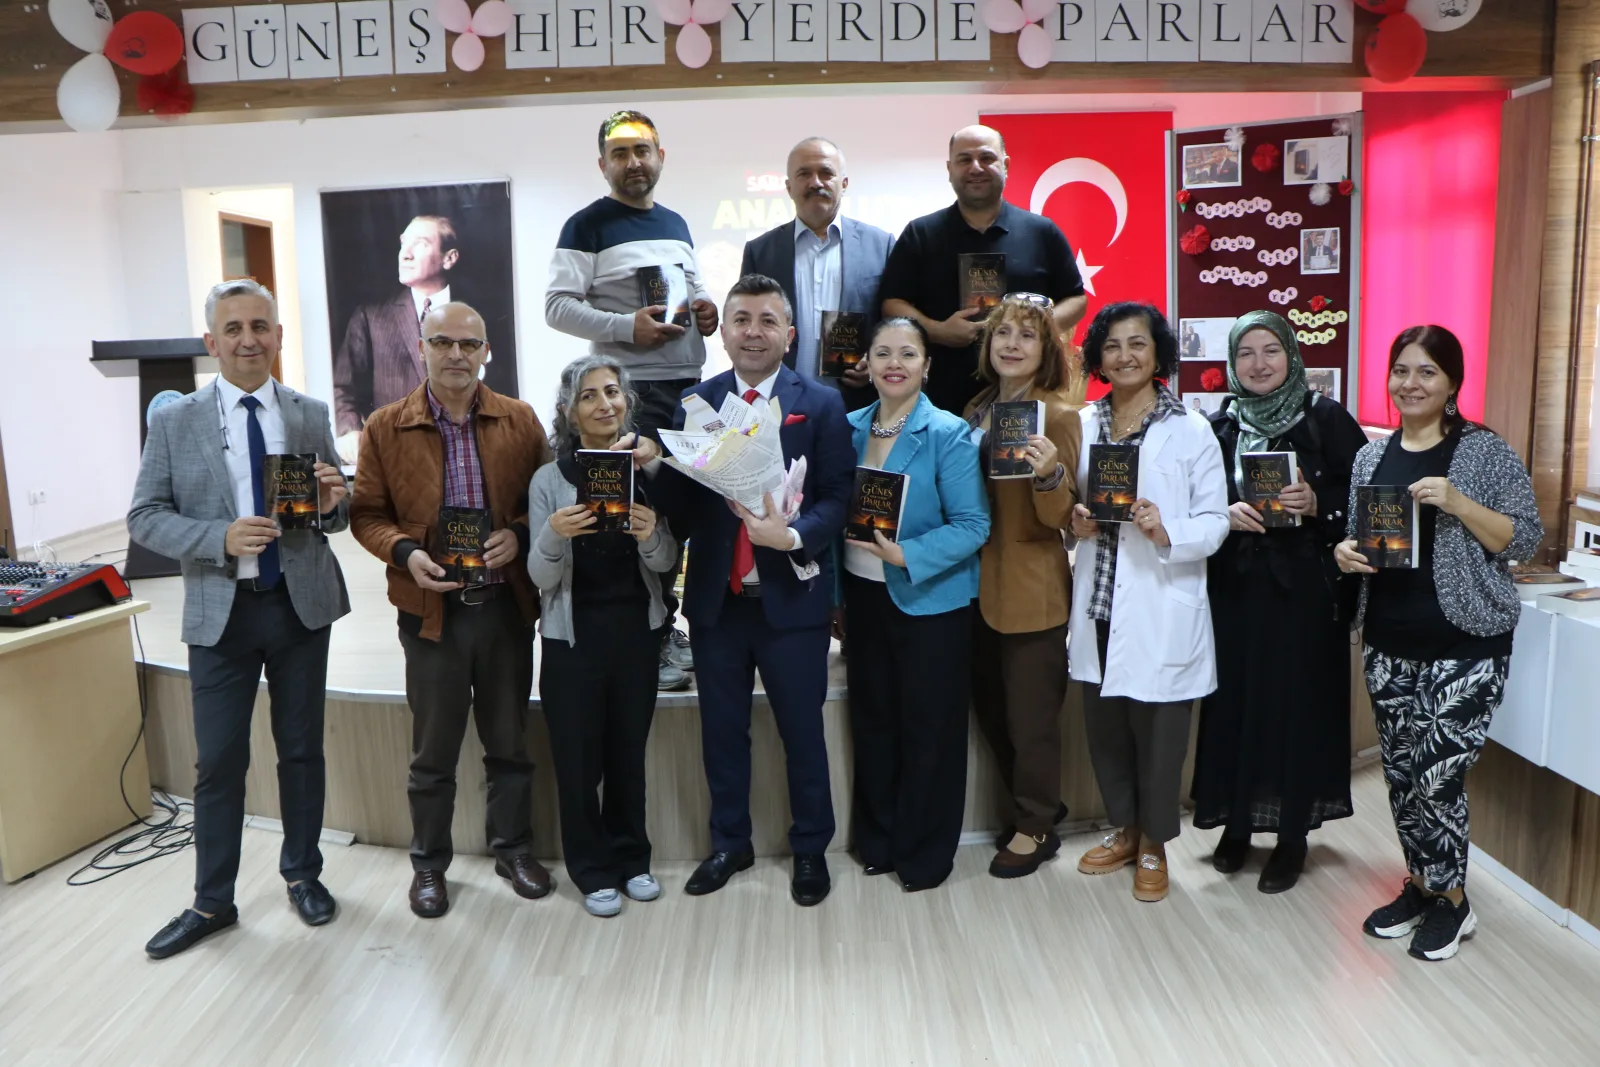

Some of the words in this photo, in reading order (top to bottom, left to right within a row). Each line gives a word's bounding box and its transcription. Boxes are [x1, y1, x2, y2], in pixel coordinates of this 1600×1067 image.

[191, 9, 432, 70] GÜNEŞ
[513, 5, 661, 53] HER
[730, 2, 978, 43] YERDE
[1056, 2, 1348, 45] PARLAR
[1368, 516, 1406, 529] PARLAR
[447, 535, 480, 548] PARLAR
